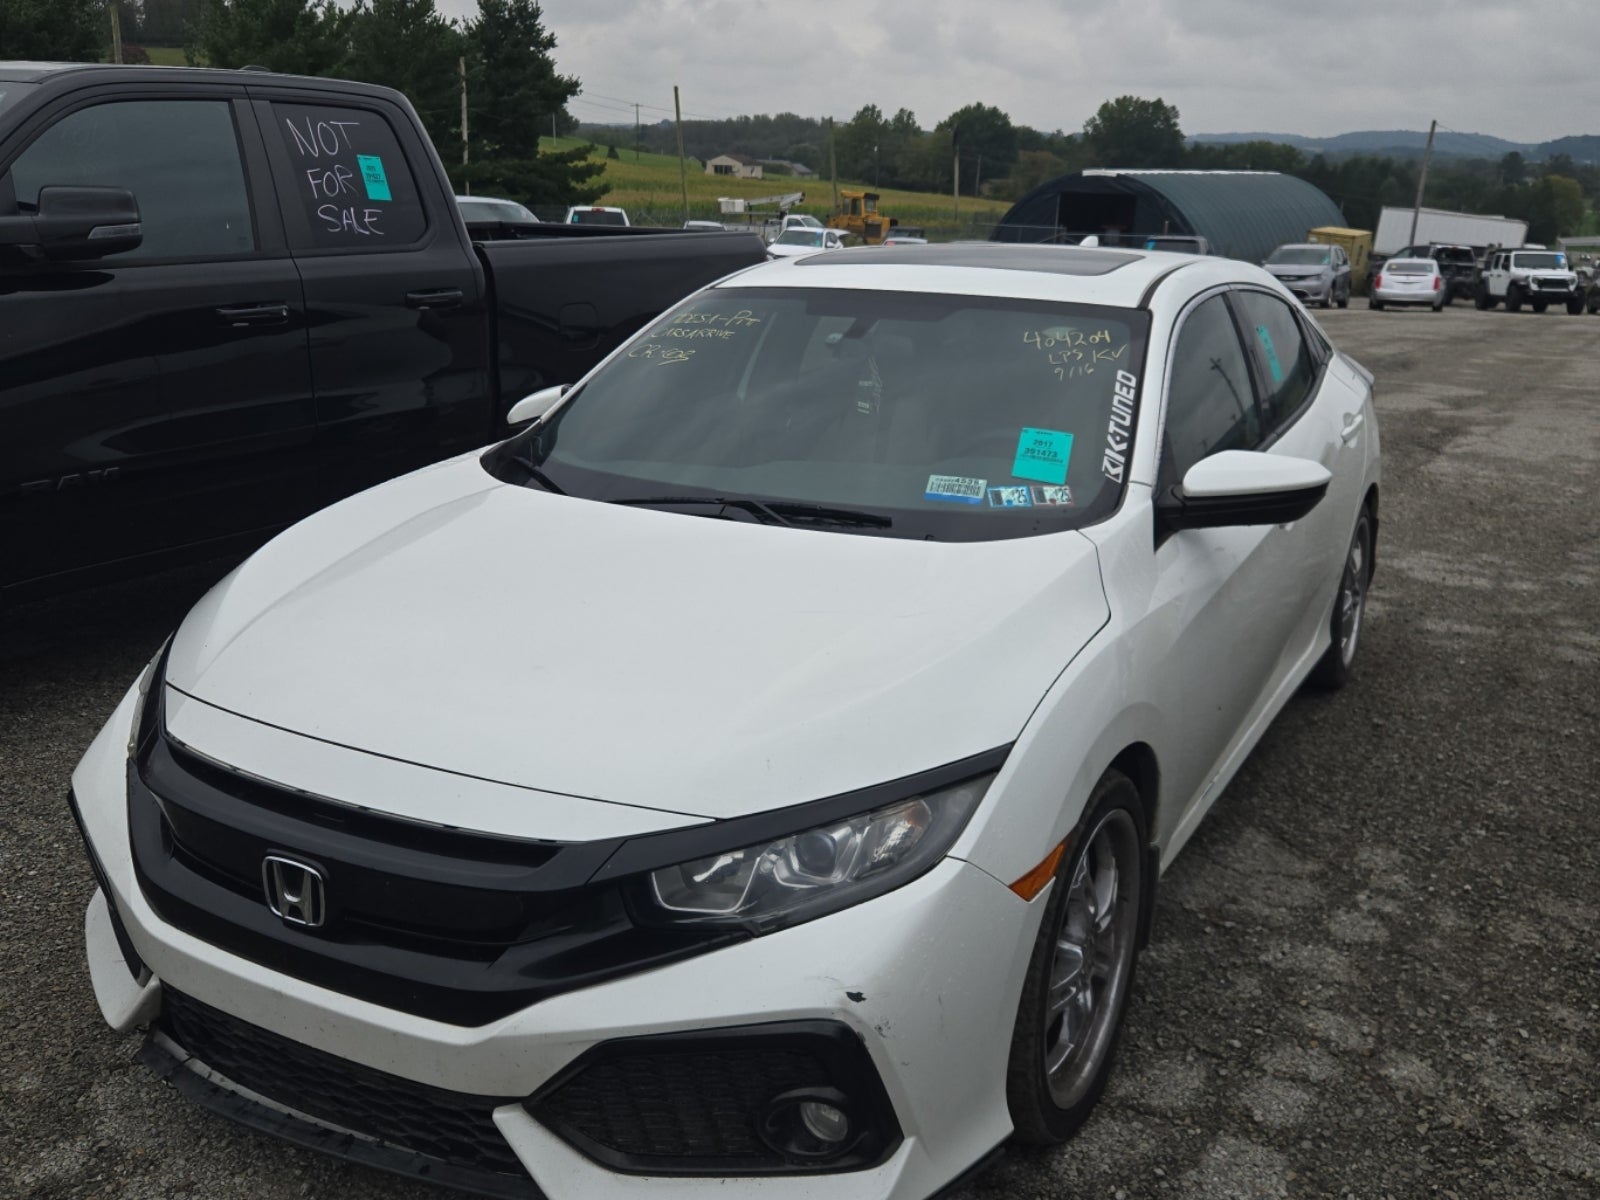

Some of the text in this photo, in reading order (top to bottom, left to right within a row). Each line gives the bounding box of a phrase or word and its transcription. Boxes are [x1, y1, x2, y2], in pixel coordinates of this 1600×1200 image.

[286, 116, 360, 157] NOT
[306, 164, 358, 199] FOR
[317, 204, 385, 235] SALE
[1023, 329, 1111, 350] 404204
[1032, 438, 1054, 448] 2017
